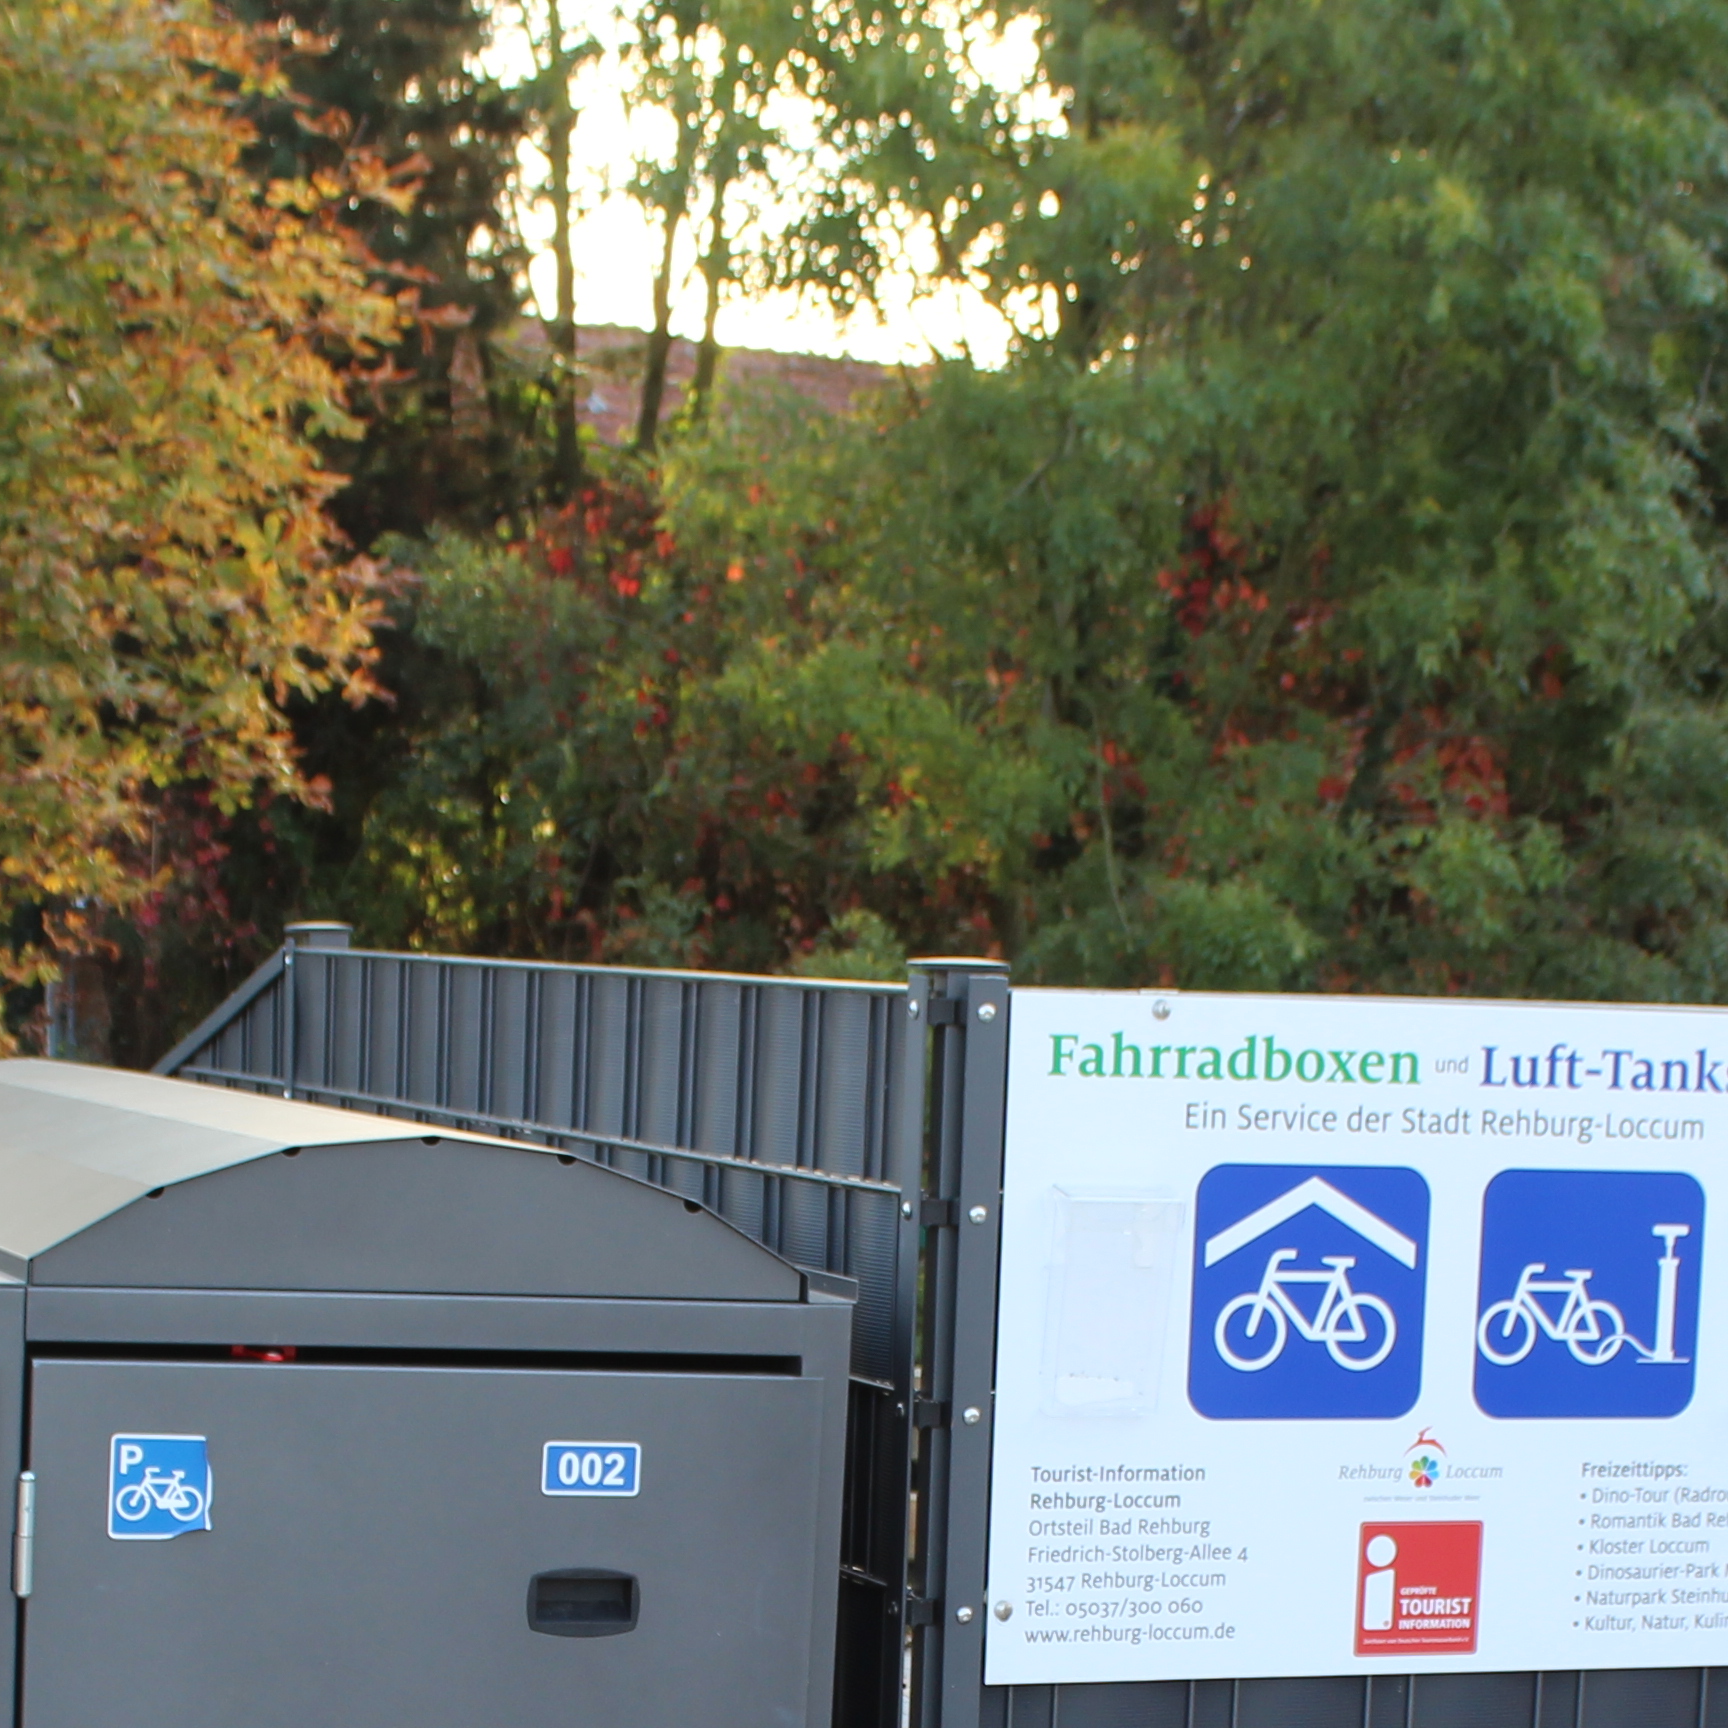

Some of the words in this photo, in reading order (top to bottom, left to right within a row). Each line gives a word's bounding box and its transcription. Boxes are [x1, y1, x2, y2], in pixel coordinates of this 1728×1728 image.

[1047, 1031, 1422, 1084] Fahrradboxen
[1434, 1055, 1469, 1075] und
[1184, 1102, 1227, 1131] Ein
[1237, 1103, 1337, 1133] Service
[1346, 1105, 1393, 1134] der
[1401, 1106, 1472, 1136] Stadt
[1480, 1109, 1705, 1144] Rehburg-Loccum
[118, 1444, 144, 1475] P
[557, 1451, 626, 1487] 002
[1030, 1464, 1206, 1483] Tourist-Information
[1337, 1464, 1403, 1483] Rehburg
[1445, 1464, 1504, 1480] Loccum
[1581, 1461, 1689, 1481] Freizeittipps:
[1030, 1492, 1182, 1513] Rehburg-Loccum
[1591, 1486, 1669, 1504] Dino-Tour
[1028, 1518, 1094, 1536] Ortsteil
[1099, 1518, 1132, 1536] Bad
[1138, 1518, 1211, 1538] Rehburg
[1590, 1512, 1666, 1529] Romantik
[1671, 1511, 1702, 1529] Bad
[1028, 1543, 1233, 1565] Friedrich-Stolberg-Allee
[1237, 1546, 1249, 1562] 4
[1588, 1538, 1645, 1555] Kloster
[1649, 1539, 1710, 1554] Loccum
[1587, 1562, 1719, 1580] Dinosaurier-Park
[1026, 1575, 1075, 1593] 31547
[1080, 1571, 1227, 1592] Rehburg-Loccum
[1025, 1600, 1060, 1617] Tel.:
[1064, 1598, 1163, 1619] 05037/300
[1167, 1597, 1204, 1614] 060
[1399, 1597, 1472, 1616] TOURIST
[1585, 1588, 1667, 1608] Naturpark
[1024, 1622, 1236, 1645] www.rehburg-loccum.de
[1398, 1618, 1472, 1630] INFORMATION
[1584, 1615, 1637, 1633] Kultur,
[1641, 1614, 1690, 1631] Natur,
